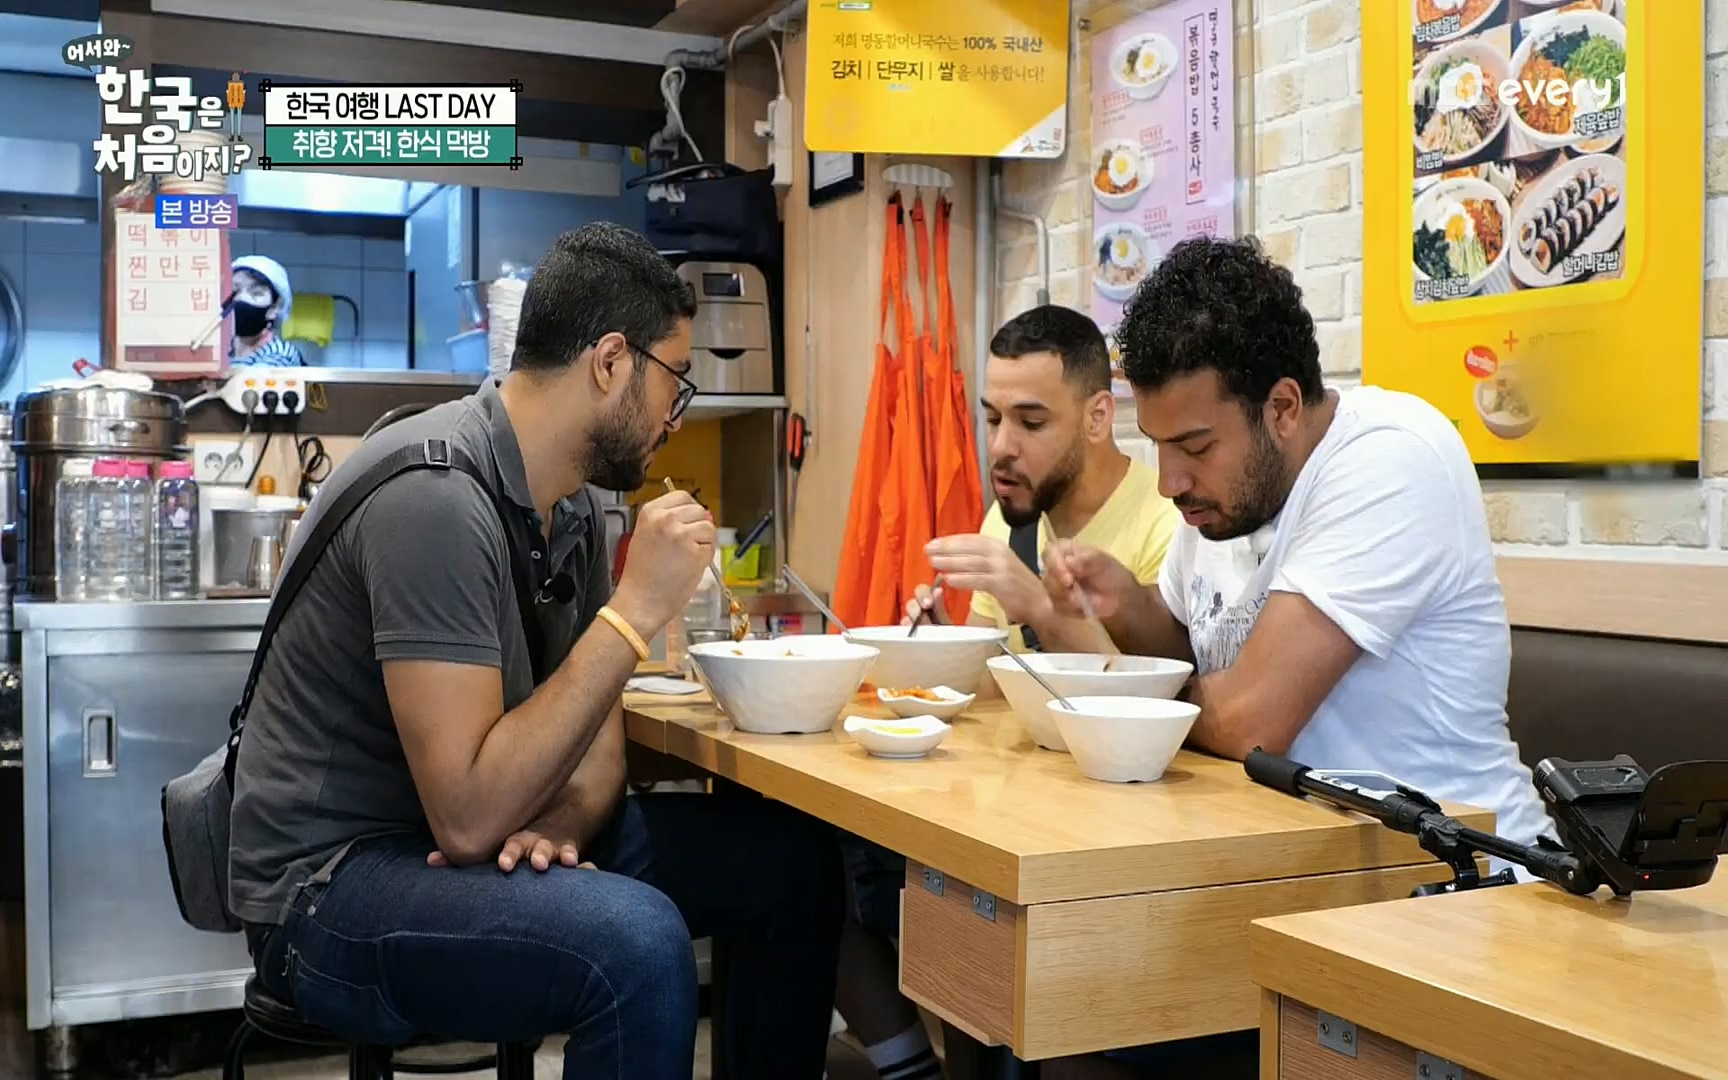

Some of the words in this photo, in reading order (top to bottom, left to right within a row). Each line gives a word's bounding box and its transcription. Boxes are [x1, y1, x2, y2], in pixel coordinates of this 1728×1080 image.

[831, 32, 858, 49] 저희
[963, 36, 997, 50] 100%
[1002, 36, 1043, 53] 국내산
[831, 59, 862, 80] 김치
[876, 60, 924, 81] 단무지
